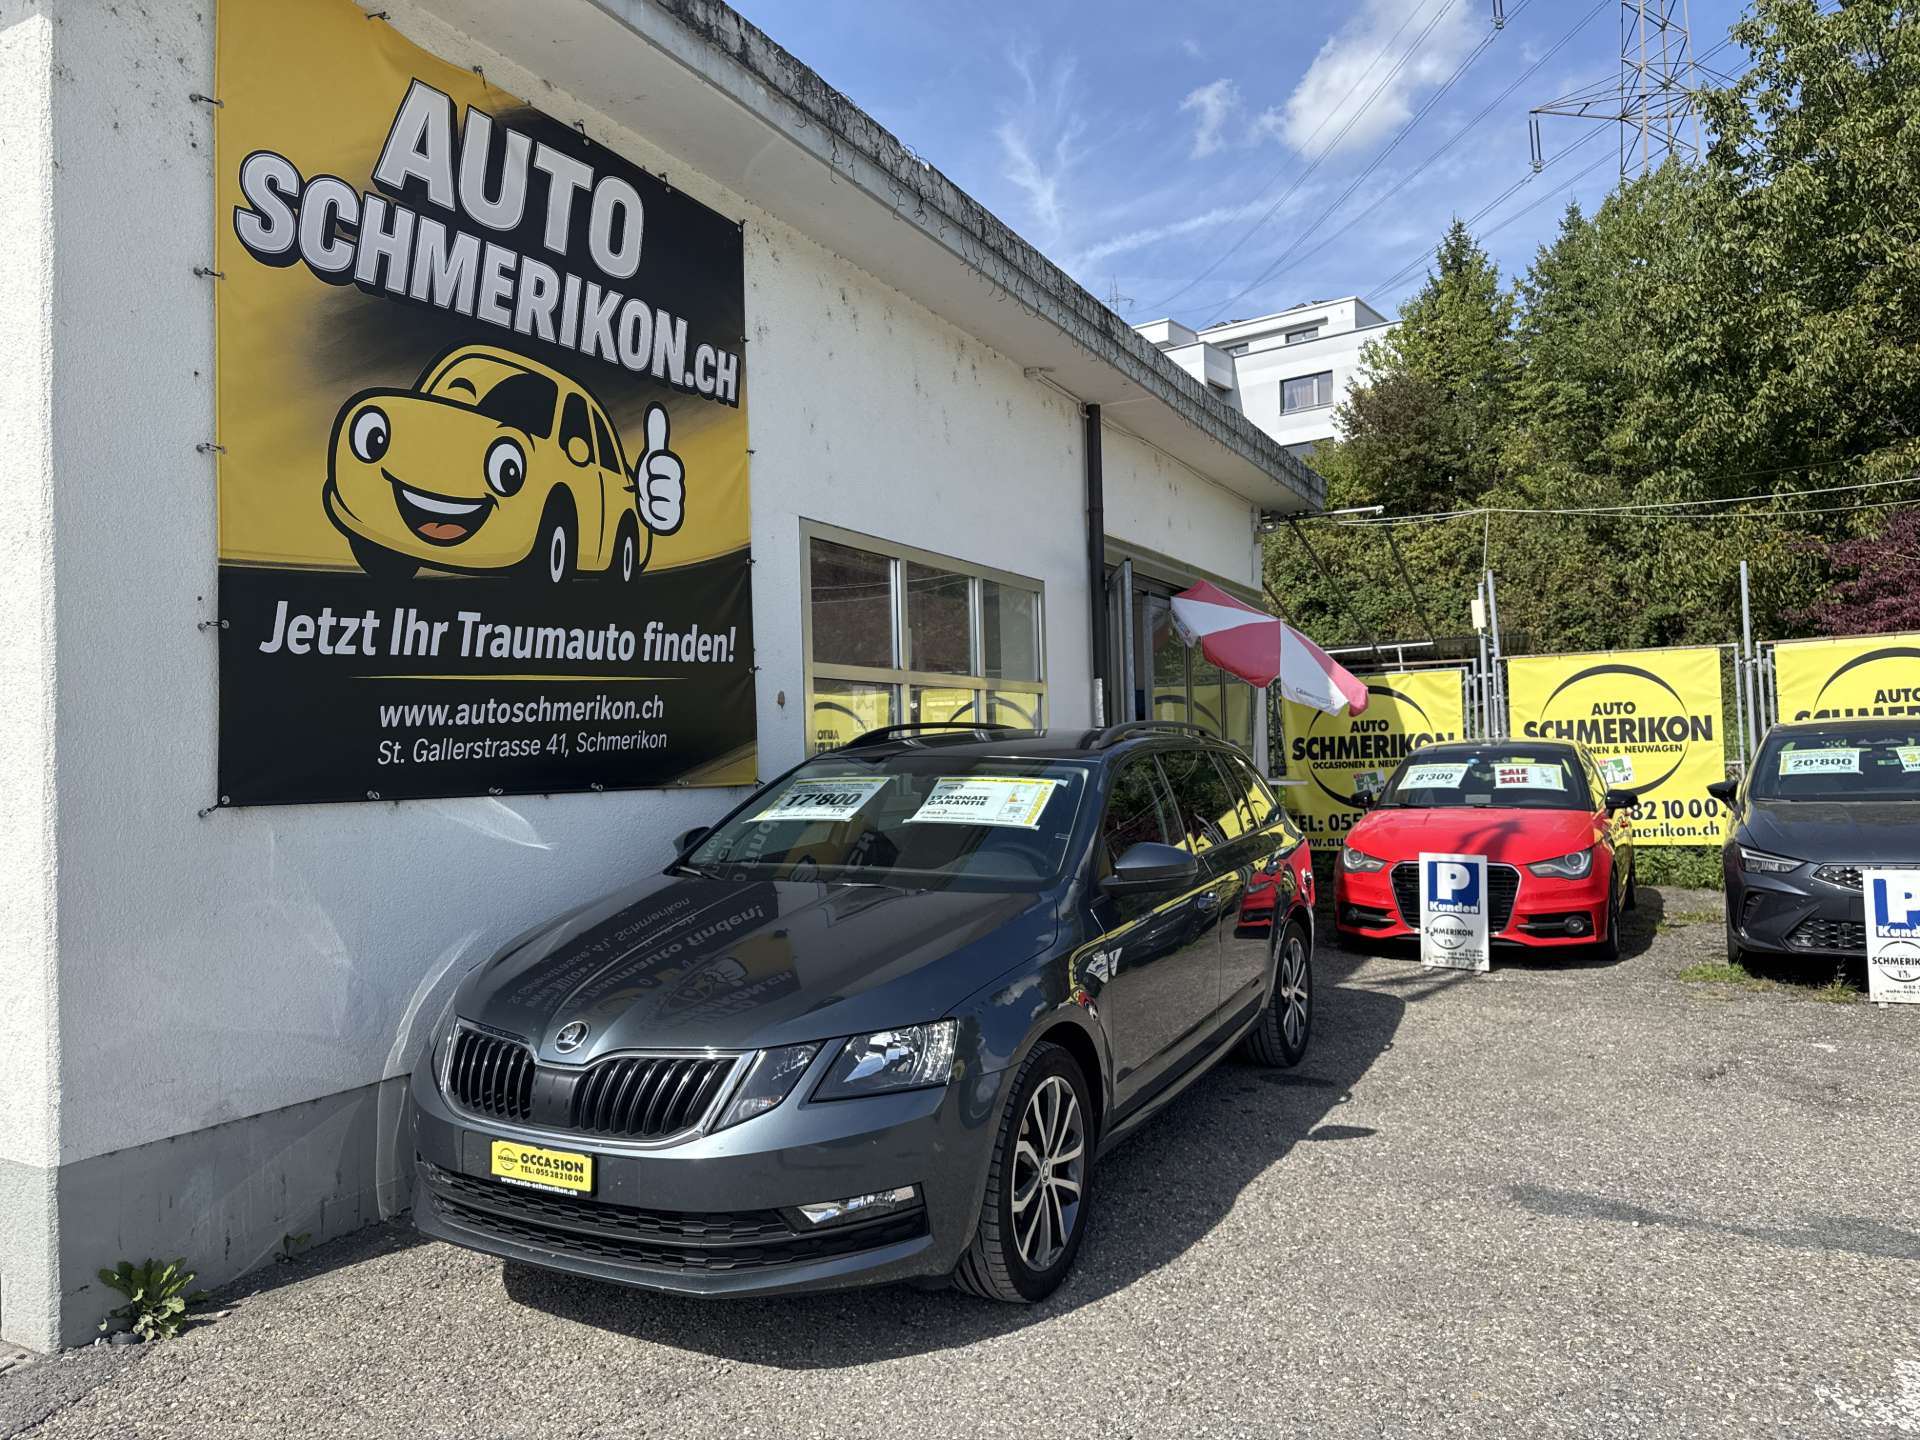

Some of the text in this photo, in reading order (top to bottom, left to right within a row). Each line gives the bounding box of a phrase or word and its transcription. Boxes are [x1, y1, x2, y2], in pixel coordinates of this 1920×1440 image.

[374, 80, 644, 279] AUTO
[235, 151, 740, 403] SCHMERIKON.CH
[259, 600, 738, 663] Jetzt Ihr Traumauto finden!
[1873, 687, 1920, 704] AUTO
[379, 694, 665, 728] www.autoschmerikon.ch
[1591, 701, 1637, 717] AUTO
[1350, 719, 1390, 734] AUTO
[1523, 715, 1713, 744] SCHMERIKON
[376, 730, 668, 766] St. Gallerstrasse 41, Schmerikon
[1613, 745, 1621, 754] &
[1624, 743, 1683, 754] NEUWAGEN
[1312, 760, 1366, 770] OCCASIONEN
[1369, 760, 1375, 768] &
[1792, 757, 1854, 767] 20'800
[1415, 773, 1454, 782] 8'300
[1499, 767, 1529, 776] SALE
[1499, 776, 1530, 785] SALE
[785, 792, 863, 808] 17'800
[927, 799, 988, 807] GARANTIE
[1662, 799, 1685, 819] 10
[1436, 862, 1471, 901] P
[1429, 901, 1480, 914] Kunden
[1871, 956, 1920, 967] SCHMERIK
[520, 1152, 584, 1174] OCCASION
[520, 1165, 535, 1175] TEL:
[535, 1168, 549, 1177] 055
